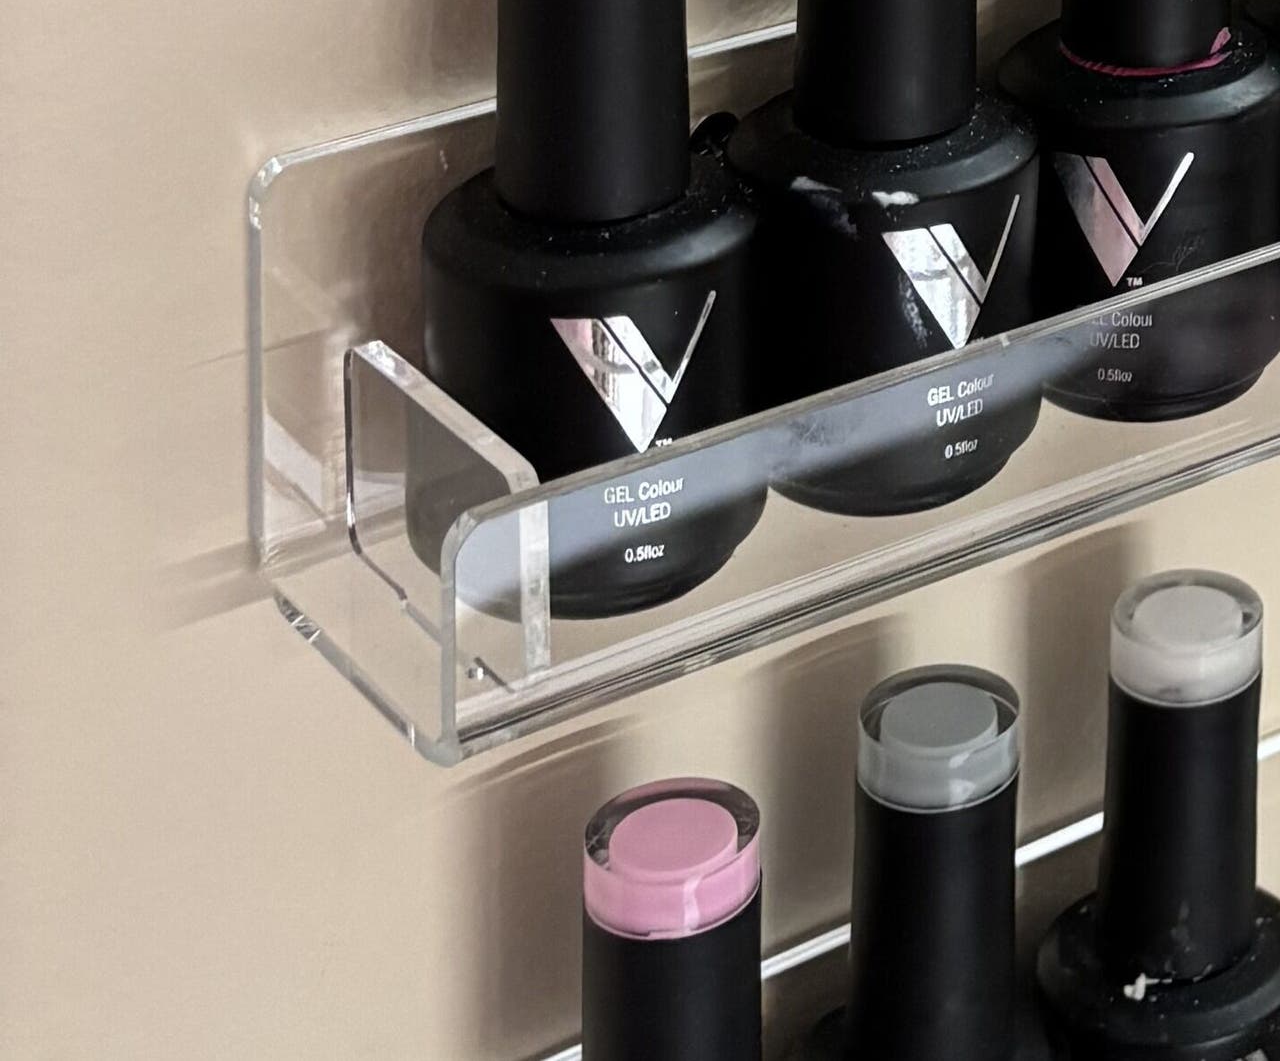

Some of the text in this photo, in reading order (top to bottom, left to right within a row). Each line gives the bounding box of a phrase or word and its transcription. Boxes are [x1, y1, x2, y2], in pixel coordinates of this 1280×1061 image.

[1089, 332, 1140, 349] UV/LED
[927, 373, 995, 407] GEL Colour
[936, 399, 984, 427] UV/LED
[604, 477, 684, 505] GEL Colour
[614, 504, 671, 527] UV/LED
